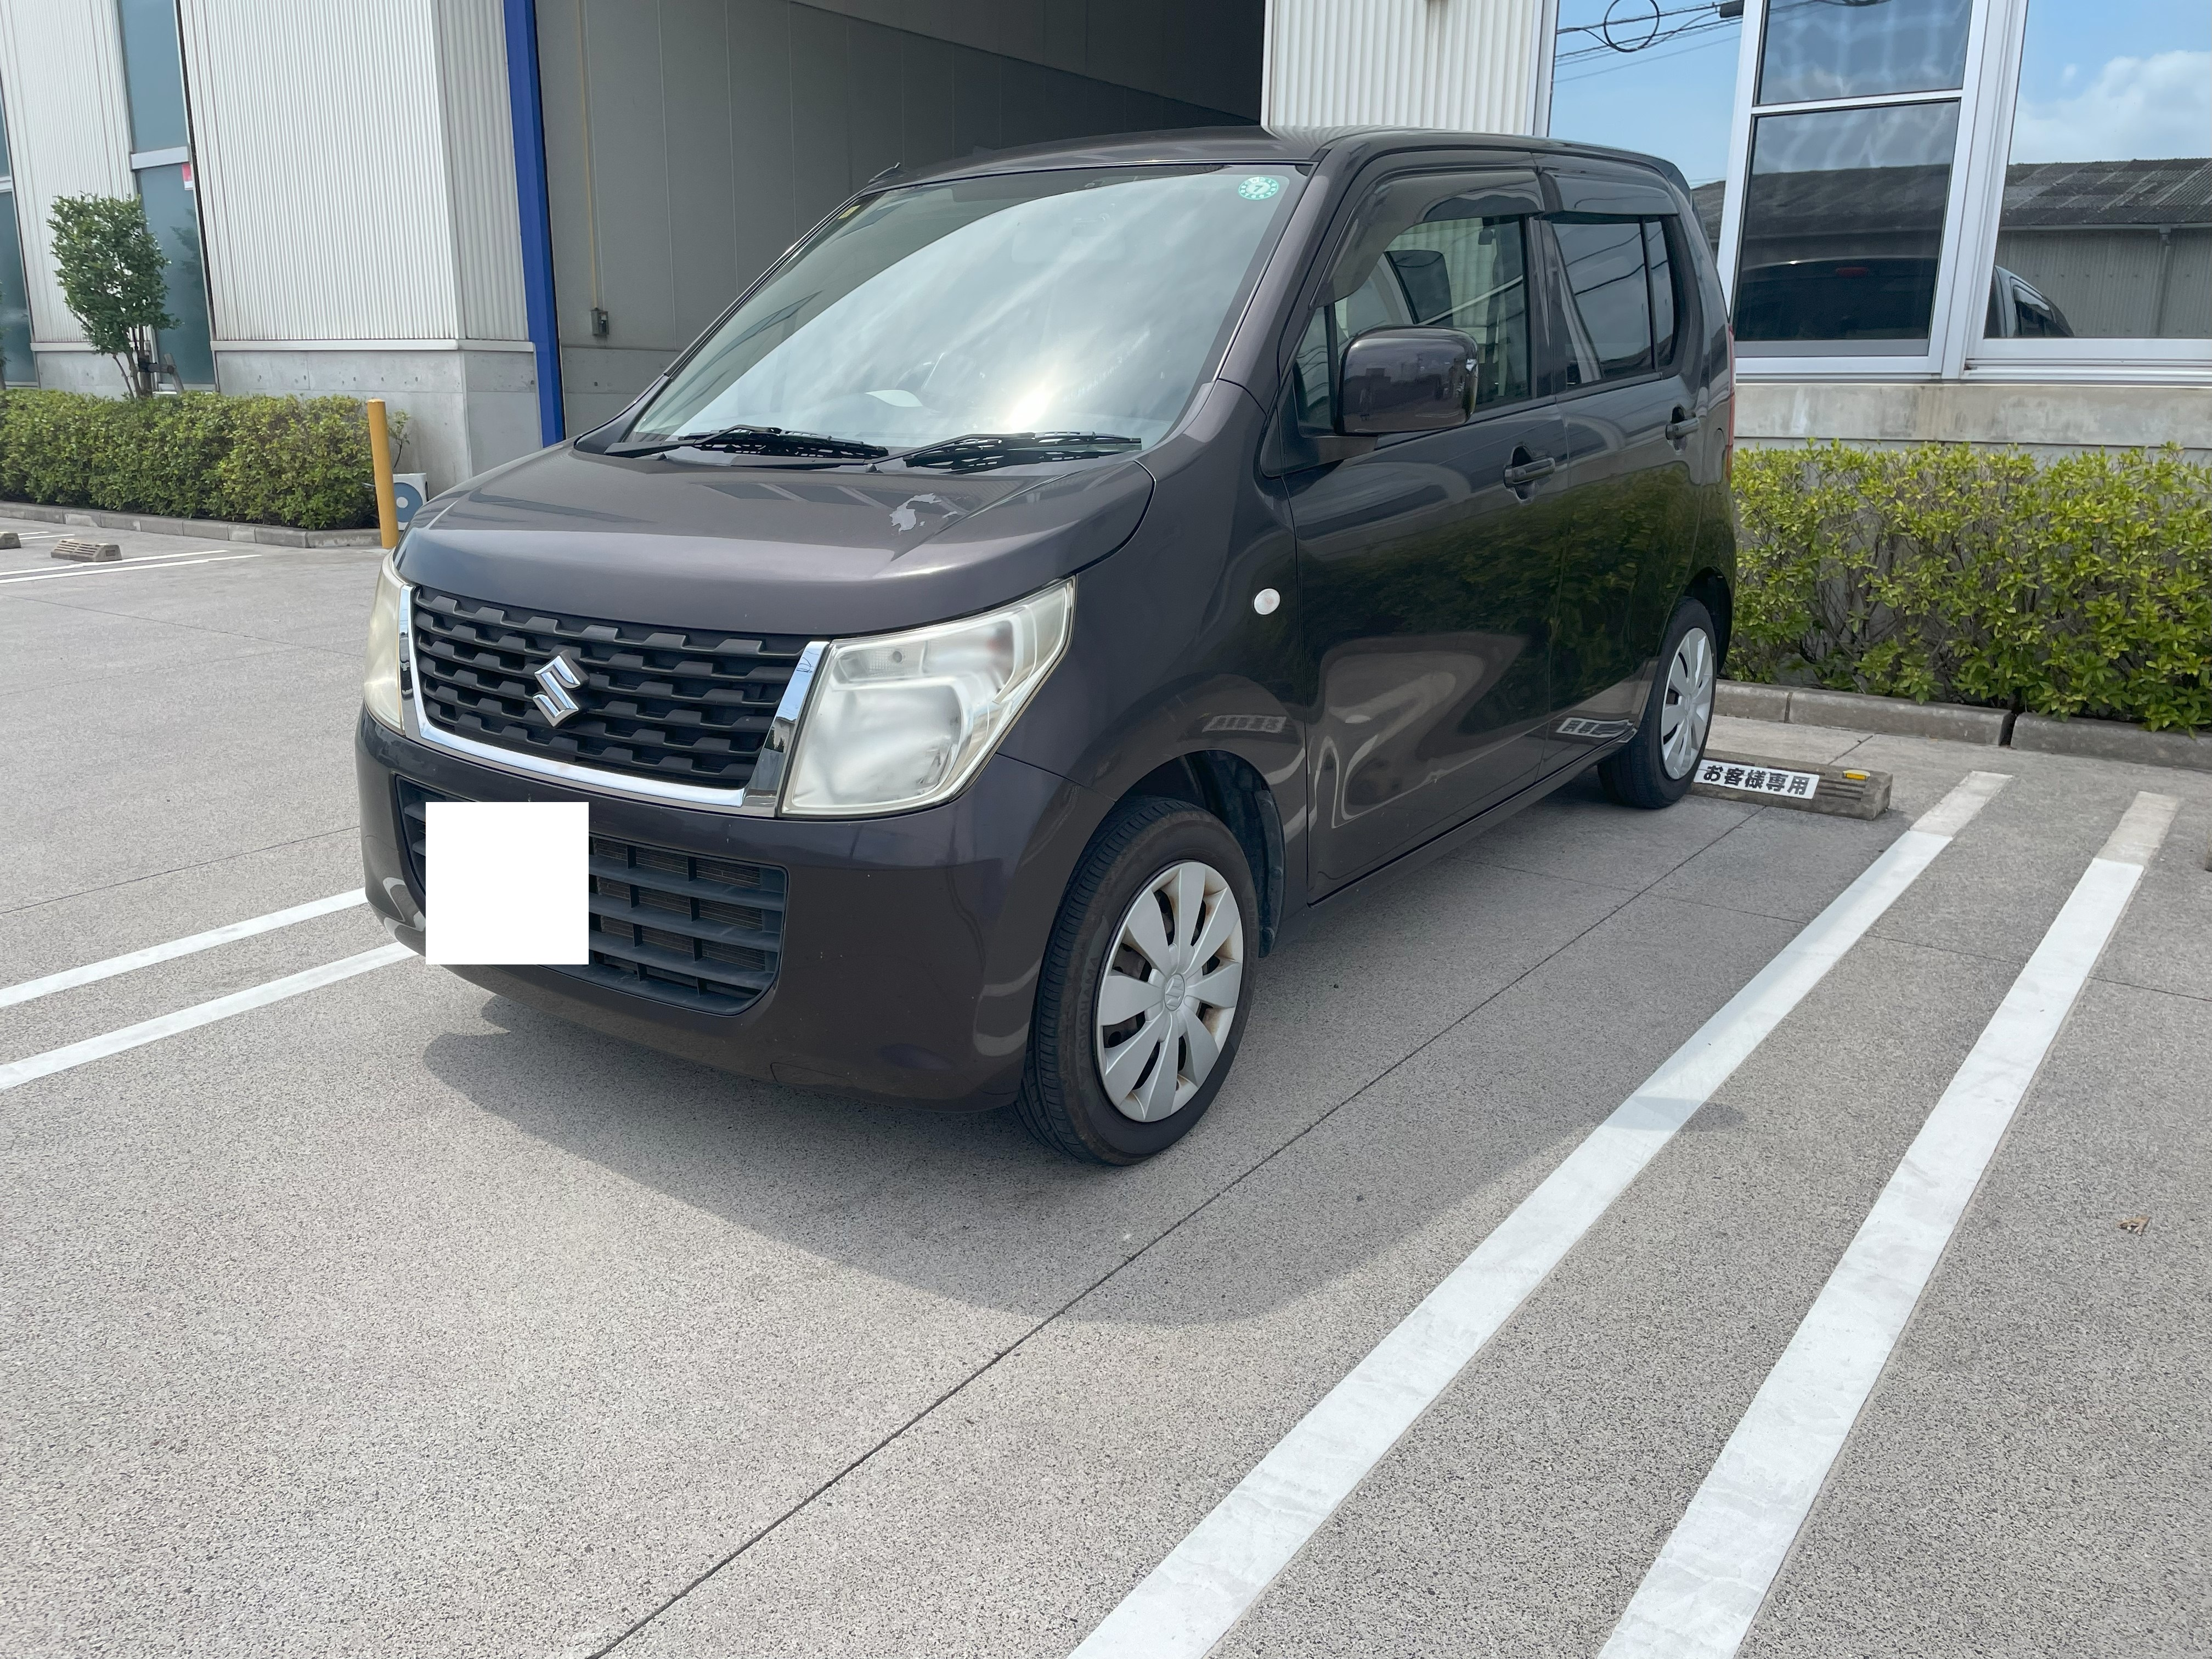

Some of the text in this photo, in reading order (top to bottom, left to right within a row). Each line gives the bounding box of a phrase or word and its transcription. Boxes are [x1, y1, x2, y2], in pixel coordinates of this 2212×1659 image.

[1703, 765, 1810, 795] お客様専用
[1079, 956, 1101, 1063] YOKOHAMA
